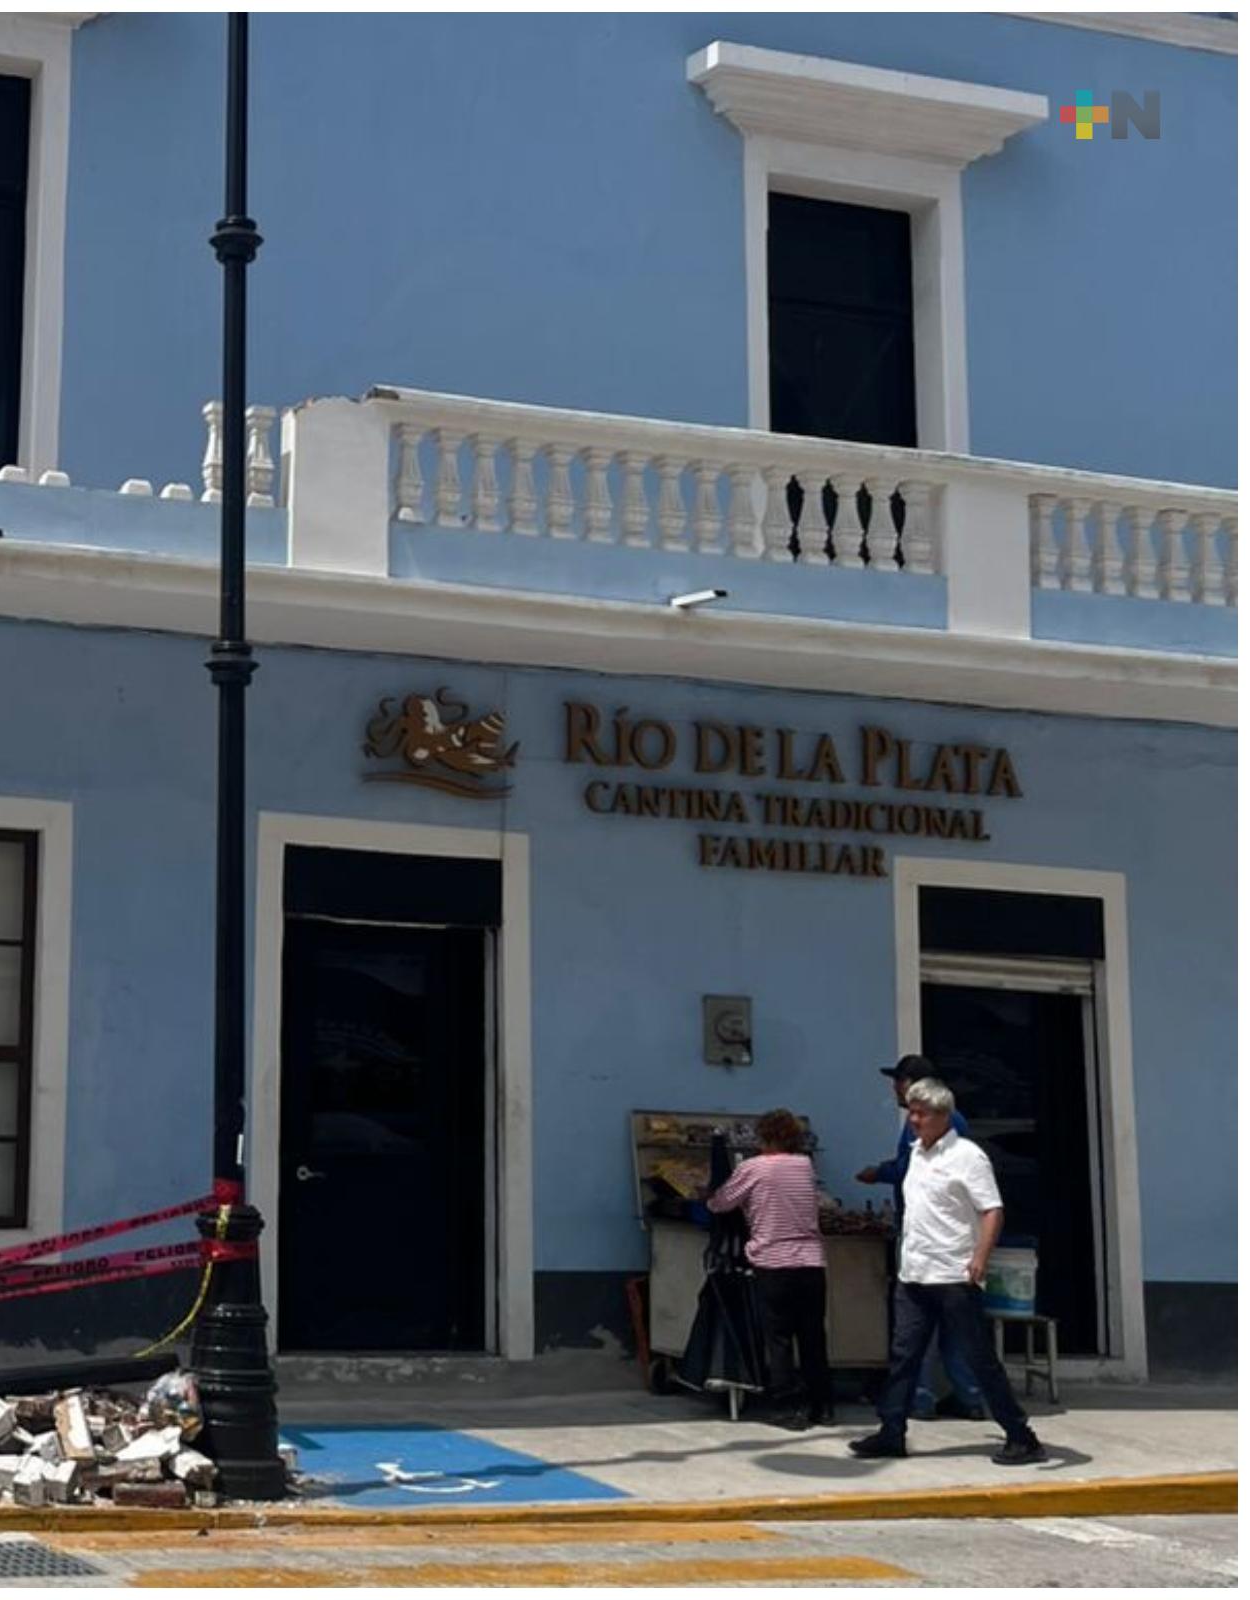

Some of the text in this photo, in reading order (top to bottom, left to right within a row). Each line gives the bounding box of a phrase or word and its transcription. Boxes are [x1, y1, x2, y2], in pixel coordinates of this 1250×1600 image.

[562, 700, 1023, 798] RÍO DE LA PLATA
[583, 780, 991, 841] CANTINA TRADICIONAL
[696, 832, 889, 878] FAMILIAR
